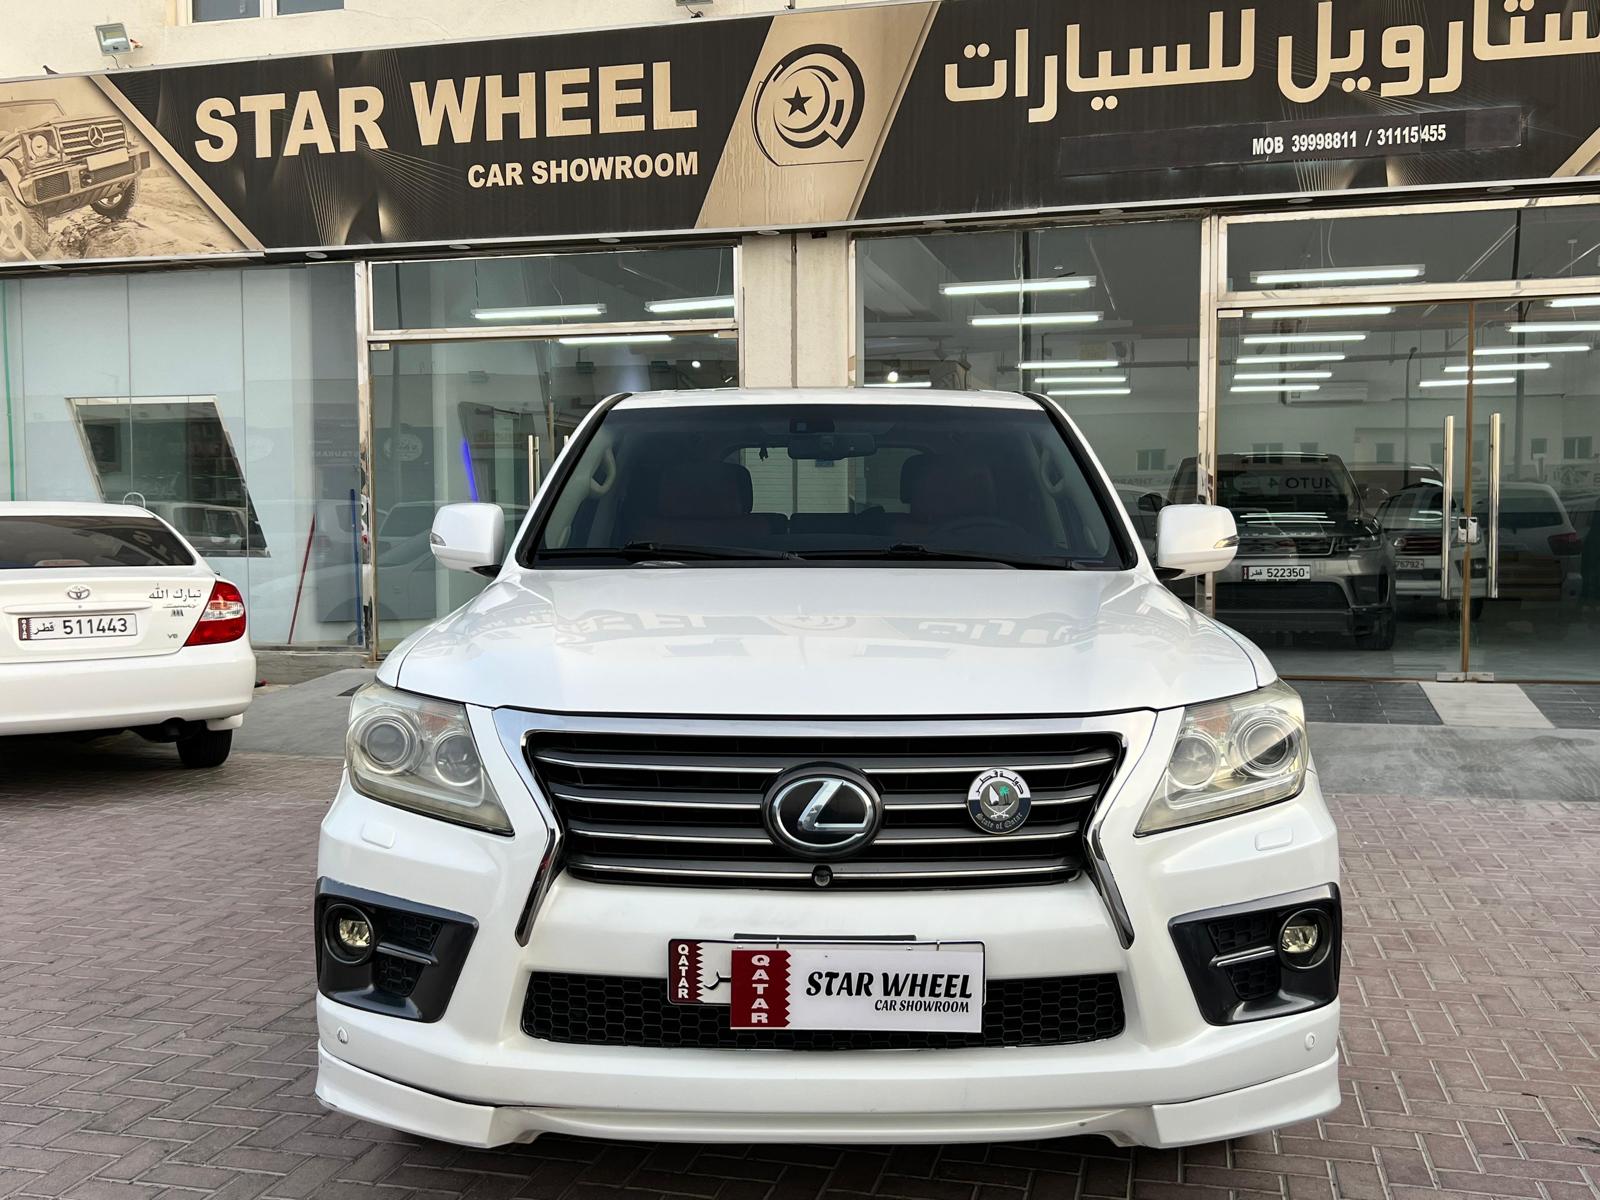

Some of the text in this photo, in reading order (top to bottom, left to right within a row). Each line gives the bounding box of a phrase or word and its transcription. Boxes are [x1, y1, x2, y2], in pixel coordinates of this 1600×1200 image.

[943, 6, 1256, 122] للسيارات
[195, 61, 697, 162] STAR WHEEL
[1252, 136, 1284, 155] MOB
[1291, 130, 1358, 153] 39998811
[1376, 123, 1447, 146] 31115455
[467, 151, 698, 189] CAR SHOWROOM
[1266, 567, 1305, 578] 522350
[149, 583, 202, 602] تبارك الله
[33, 620, 55, 635] قطر
[62, 617, 128, 636] 511443
[677, 943, 690, 999] QATAR
[805, 971, 972, 999] STAR WHEEL
[751, 954, 769, 1024] QATAR
[874, 999, 970, 1013] CAR SHOWROOM
